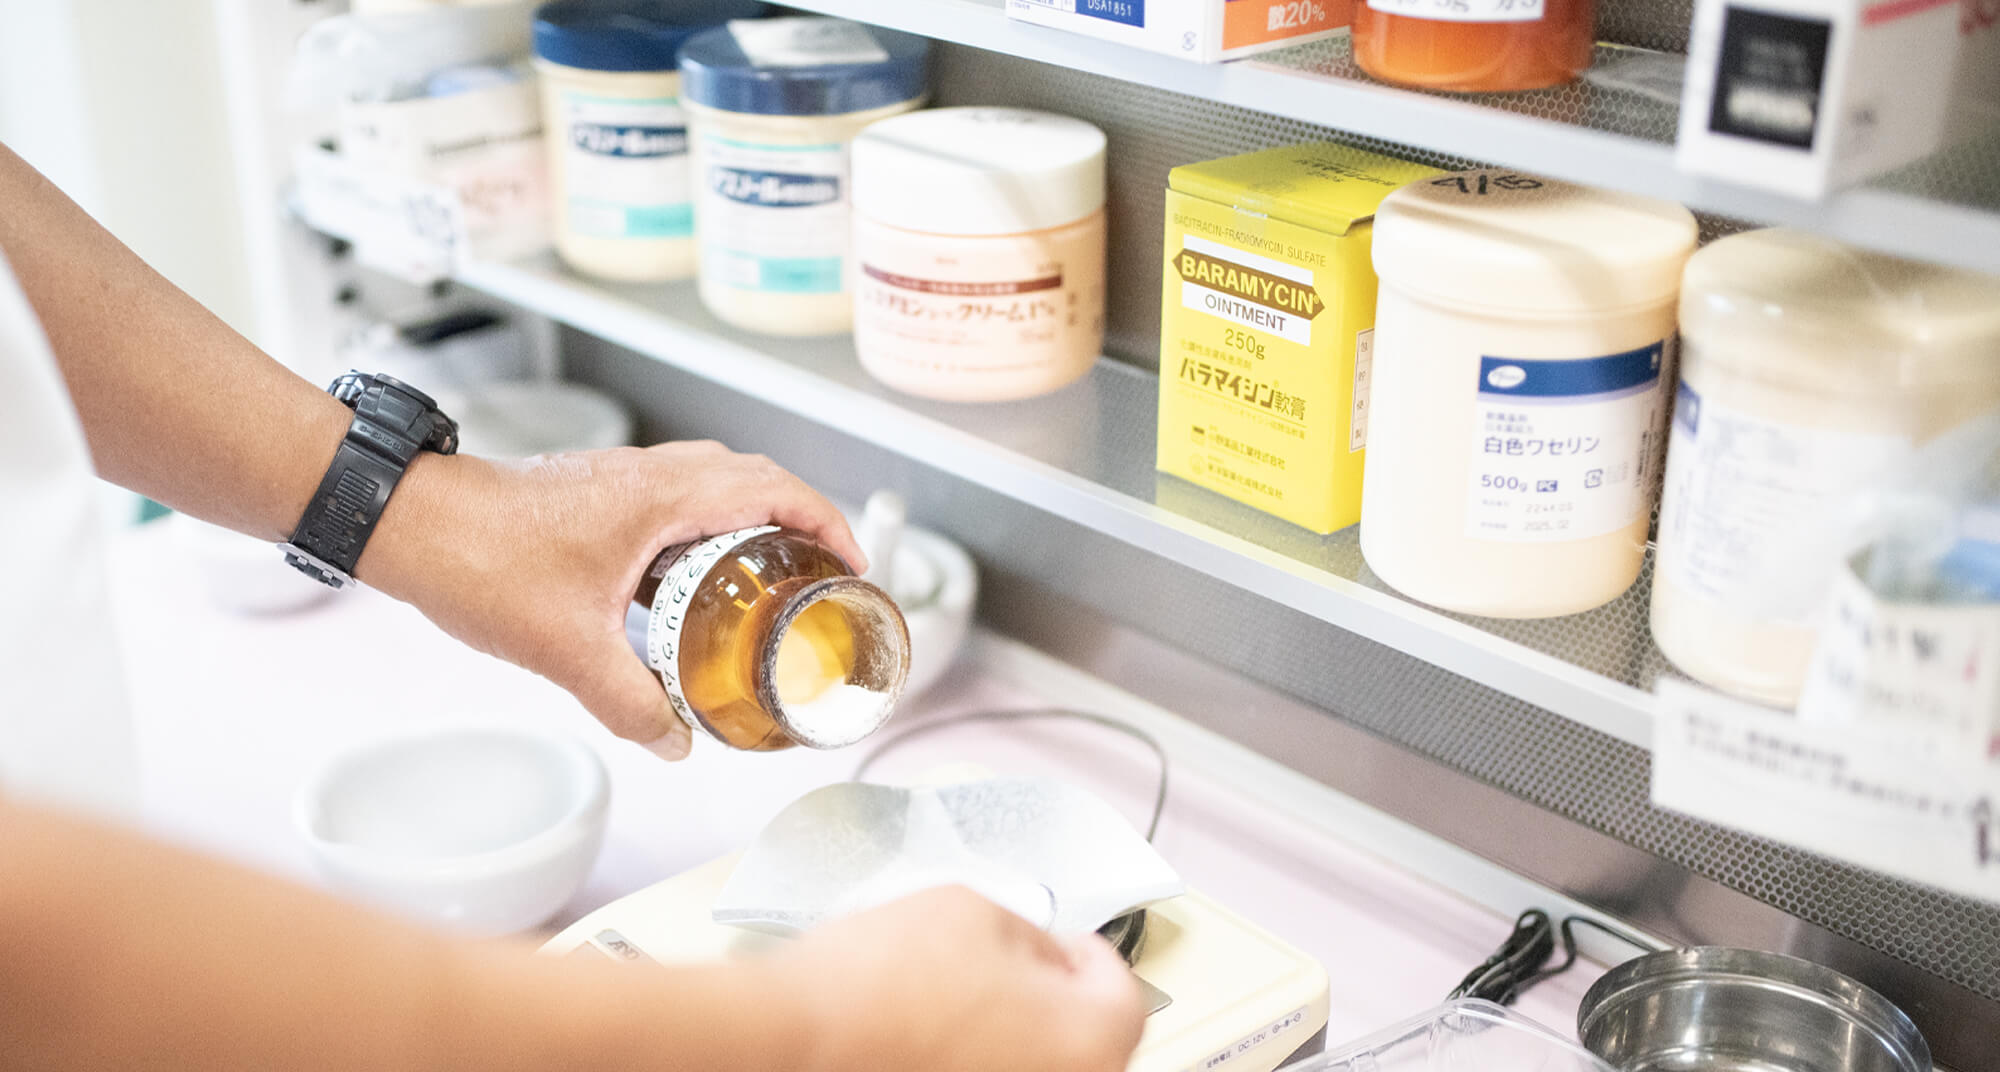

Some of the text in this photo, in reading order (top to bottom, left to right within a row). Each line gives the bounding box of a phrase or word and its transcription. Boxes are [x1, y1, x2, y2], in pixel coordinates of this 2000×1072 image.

[1286, 246, 1328, 268] SULFATE
[1181, 254, 1314, 315] BARAMYCIN
[1205, 294, 1287, 332] OINTMENT
[1225, 328, 1266, 361] 250g
[1484, 436, 1601, 456] 白色ワセリン
[1481, 474, 1528, 493] 500g
